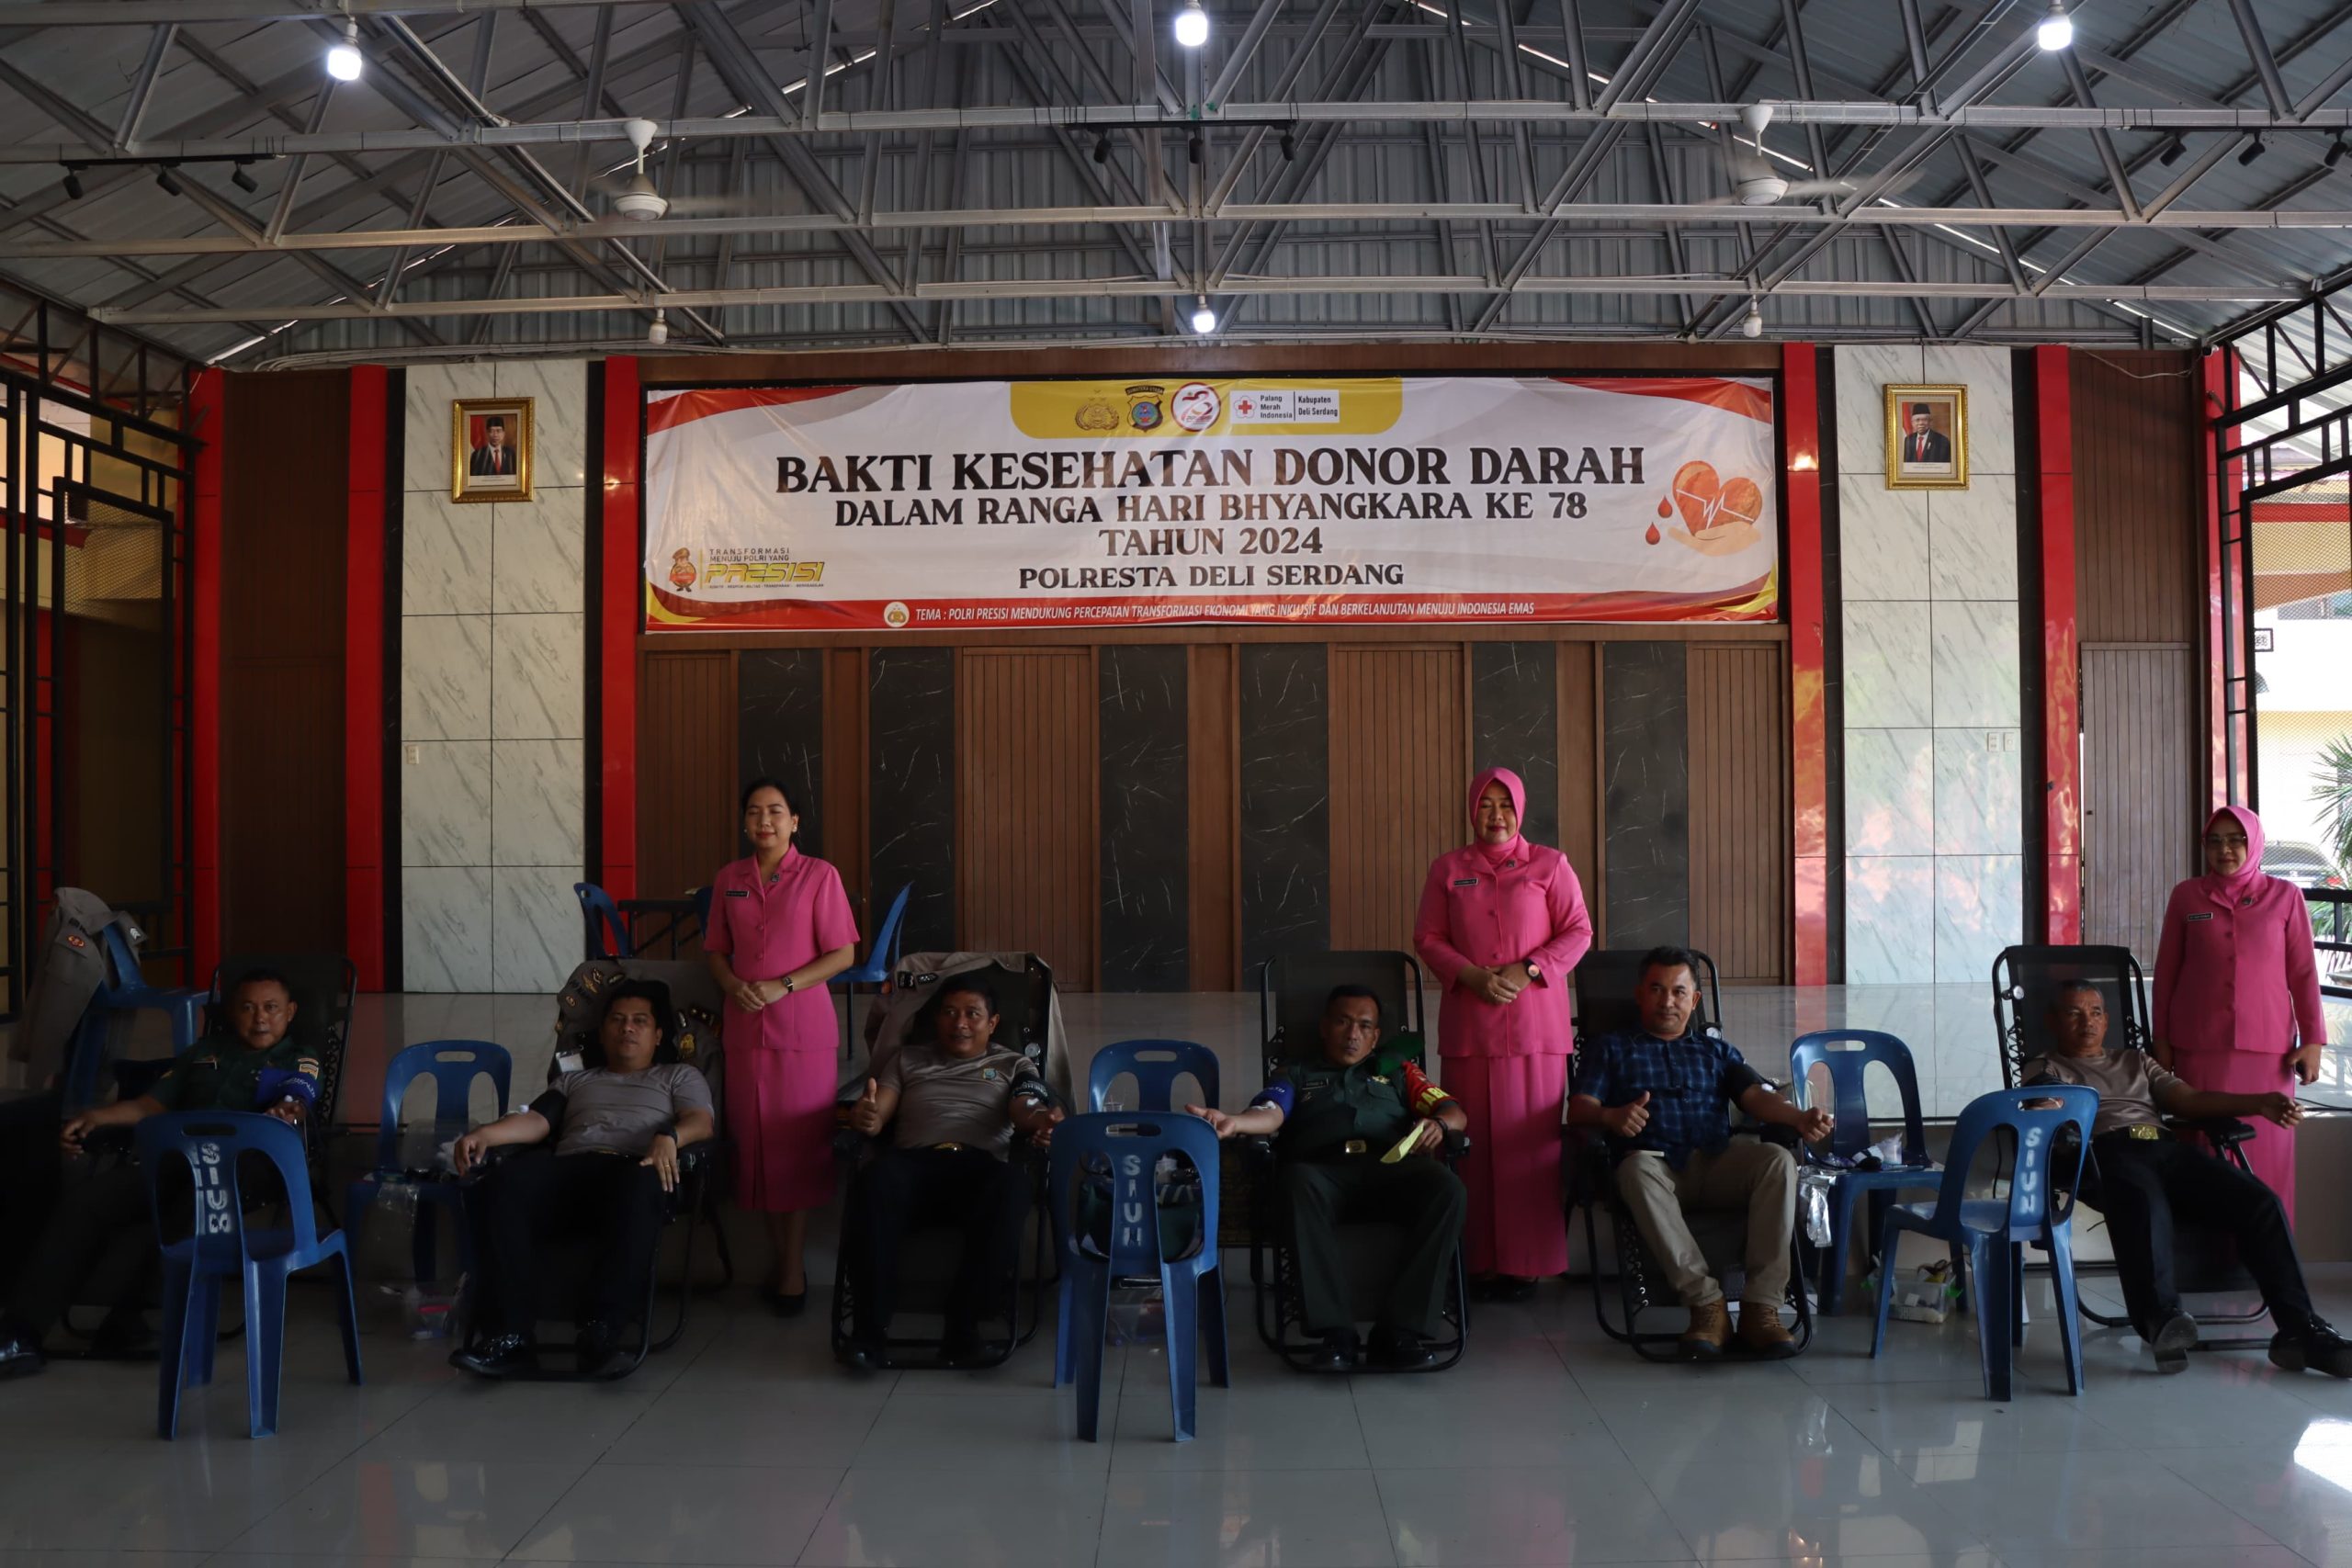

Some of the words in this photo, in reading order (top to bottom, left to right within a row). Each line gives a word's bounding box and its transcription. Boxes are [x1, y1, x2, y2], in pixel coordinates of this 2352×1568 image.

[1298, 407, 1311, 415] Deli
[1312, 407, 1338, 417] Serdang
[776, 454, 933, 493] BAKTI
[952, 449, 1253, 491] KESEHATAN
[1272, 446, 1451, 486] DONOR
[1469, 446, 1645, 485] DARAH
[835, 498, 964, 526] DALAM
[977, 496, 1103, 525] RANGA
[1116, 494, 1205, 523] HARI
[1220, 491, 1473, 521] BHYANGKARA
[1486, 491, 1533, 520] KE
[1548, 491, 1588, 520] 78
[709, 547, 790, 556] TRANSFORMASI
[1098, 527, 1225, 557] TAHUN
[1239, 526, 1323, 555] 2024
[704, 561, 825, 583] PRESISI
[1019, 567, 1178, 589] POLRESTA
[1188, 565, 1254, 588] DELI
[1267, 564, 1405, 587] SERDANG
[916, 608, 942, 621] TEMA
[948, 608, 975, 620] POLRI
[977, 607, 1009, 620] PRESISI
[1011, 606, 1072, 619] MENDUKUNG
[1073, 605, 1130, 618] PERCEPATAN
[1131, 604, 1202, 618] TRANSFORMASI
[1204, 604, 1249, 616] EKONOMI
[1250, 604, 1275, 615] YANG
[1277, 603, 1317, 616] INKLUSIF
[1318, 604, 1339, 615] DAN
[1340, 603, 1415, 615] BERKELANJUTAN
[1417, 603, 1455, 615] MENUJU
[1457, 602, 1507, 615] INDONESIA
[1509, 602, 1535, 615] EMAS
